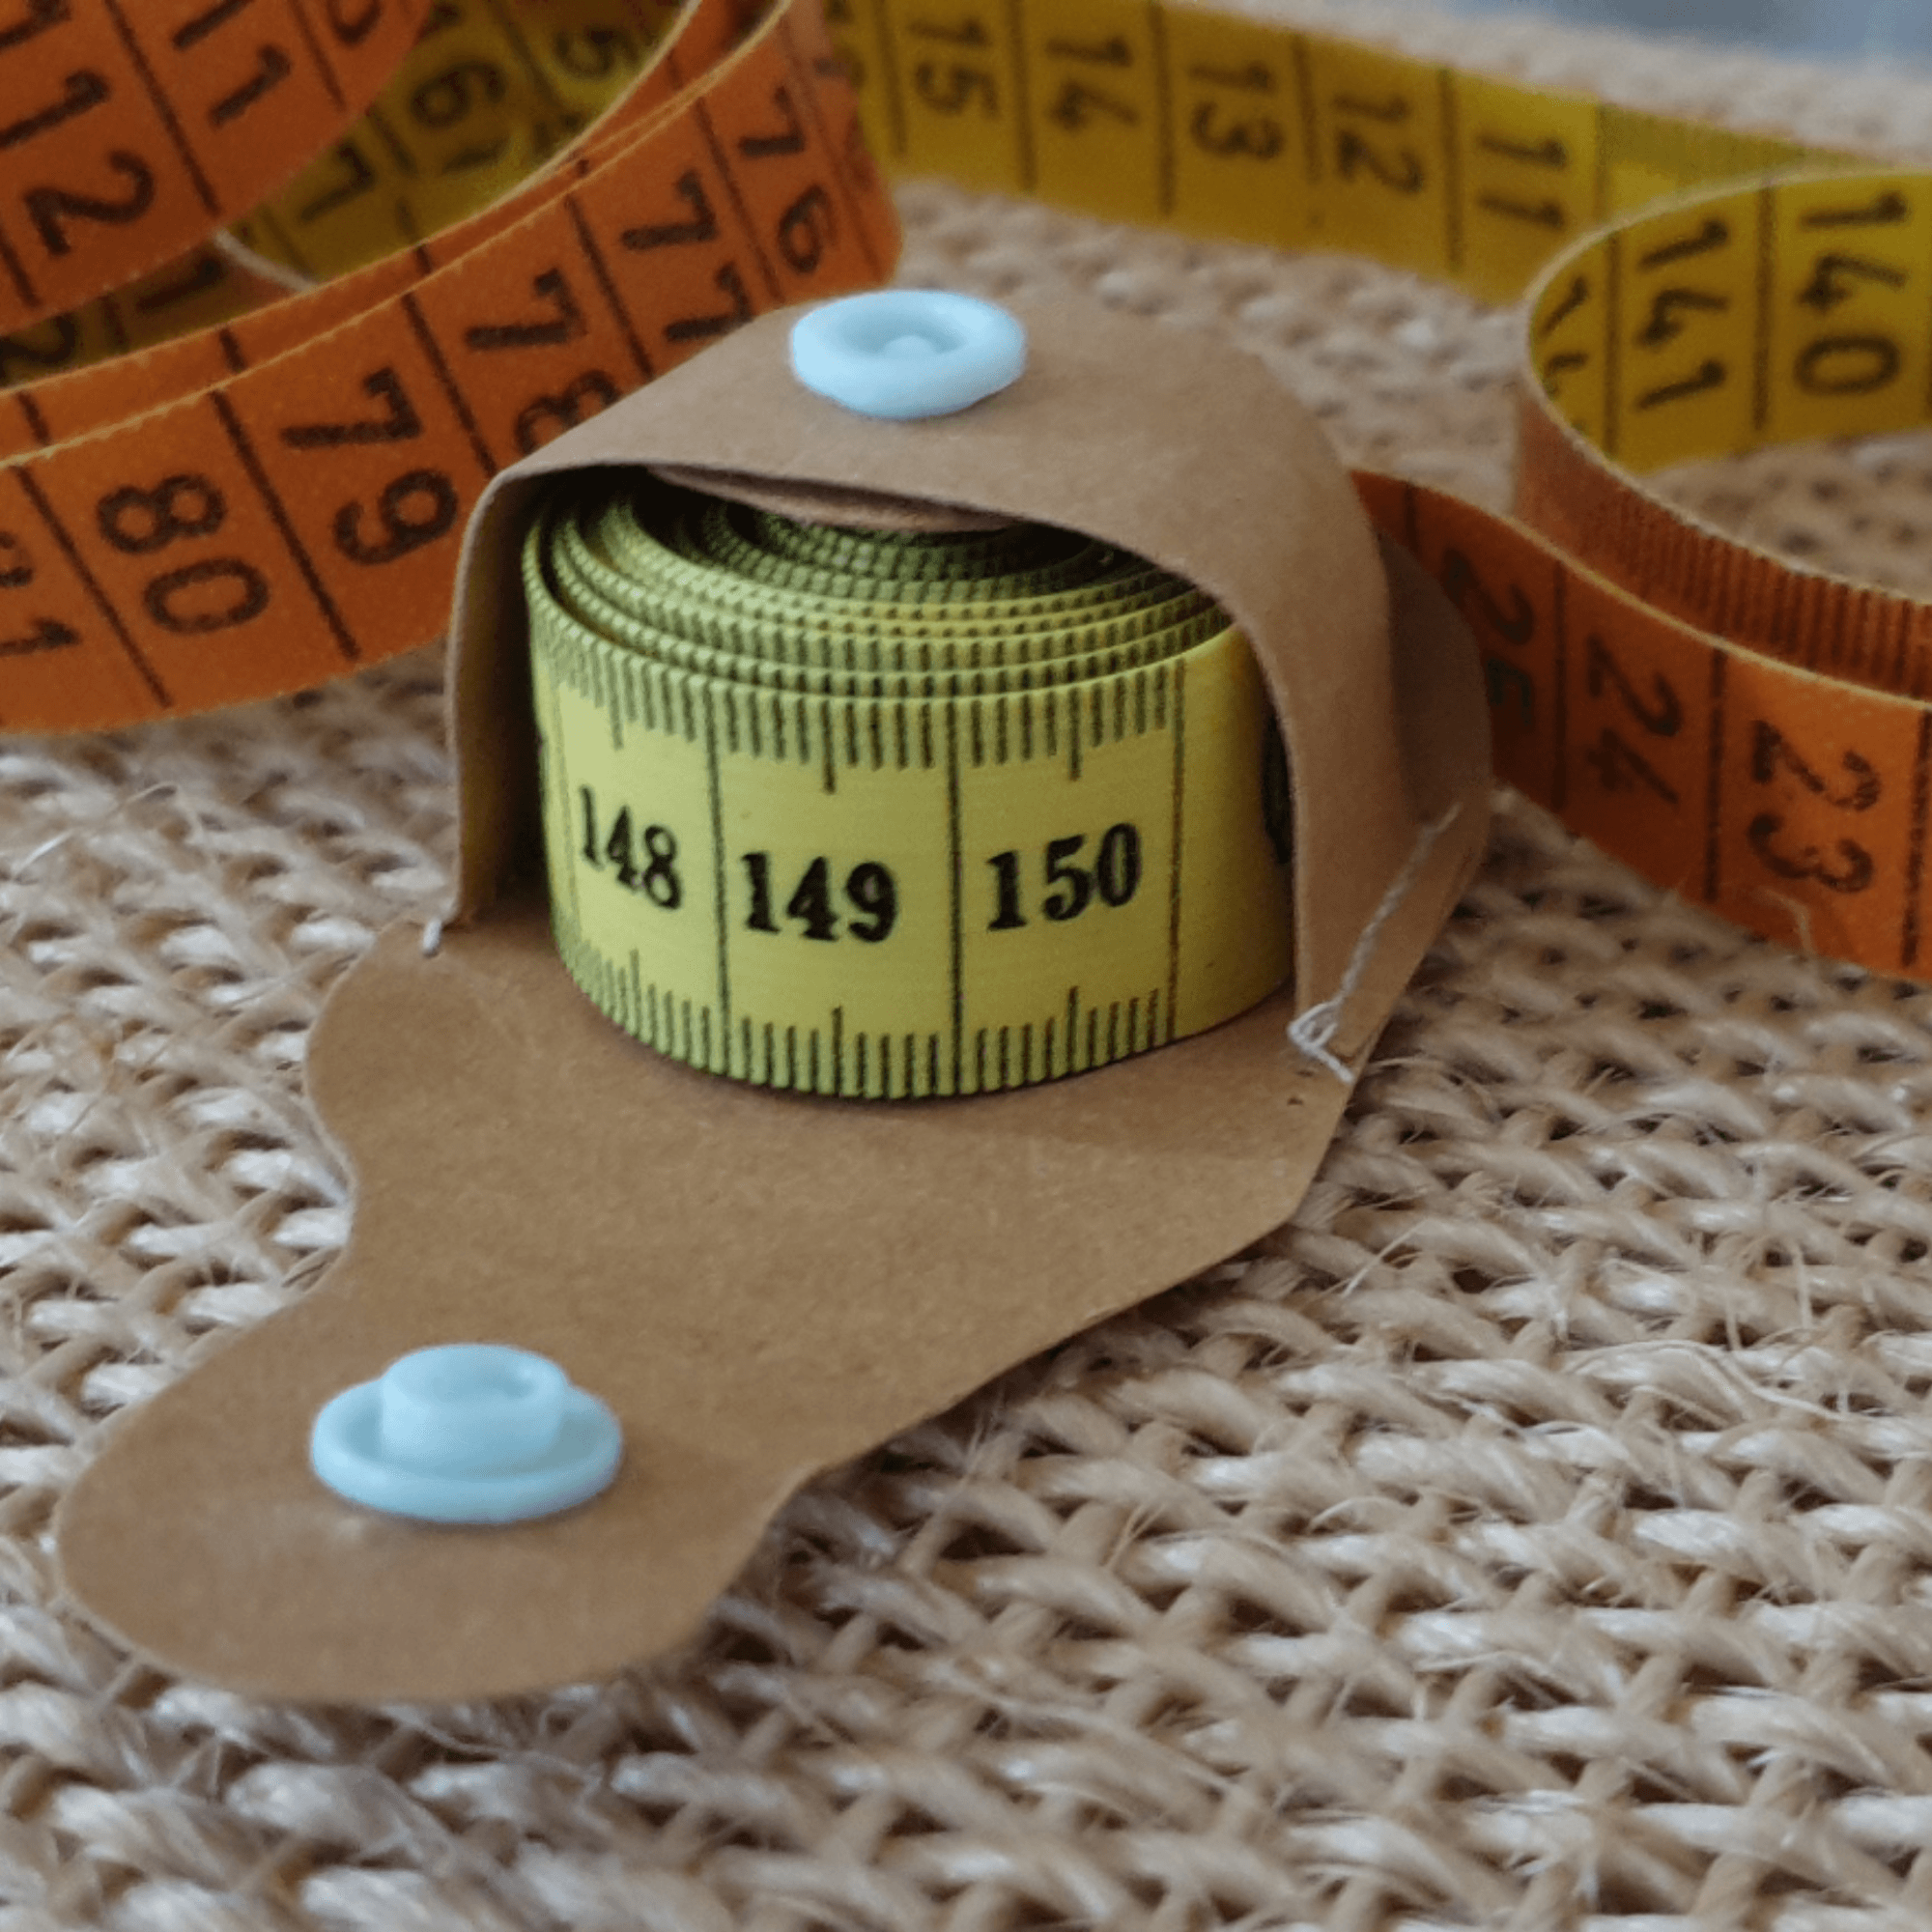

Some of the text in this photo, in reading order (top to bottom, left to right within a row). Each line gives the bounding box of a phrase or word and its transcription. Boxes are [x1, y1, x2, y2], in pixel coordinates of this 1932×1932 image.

[906, 17, 1000, 120] 15
[1046, 33, 1140, 133] 14
[1187, 58, 1287, 161] 13
[738, 83, 838, 276] 76
[1332, 94, 1427, 197] 12
[1473, 129, 1569, 235] 11
[619, 168, 756, 345] 77
[1633, 217, 1731, 412] 141
[1793, 189, 1909, 396] 140
[278, 365, 460, 567] 79
[97, 472, 271, 637] 80
[1587, 633, 1683, 806] 24
[580, 785, 682, 909] 148
[987, 821, 1142, 931] 150
[1747, 717, 1883, 894] 23
[741, 850, 898, 943] 149
